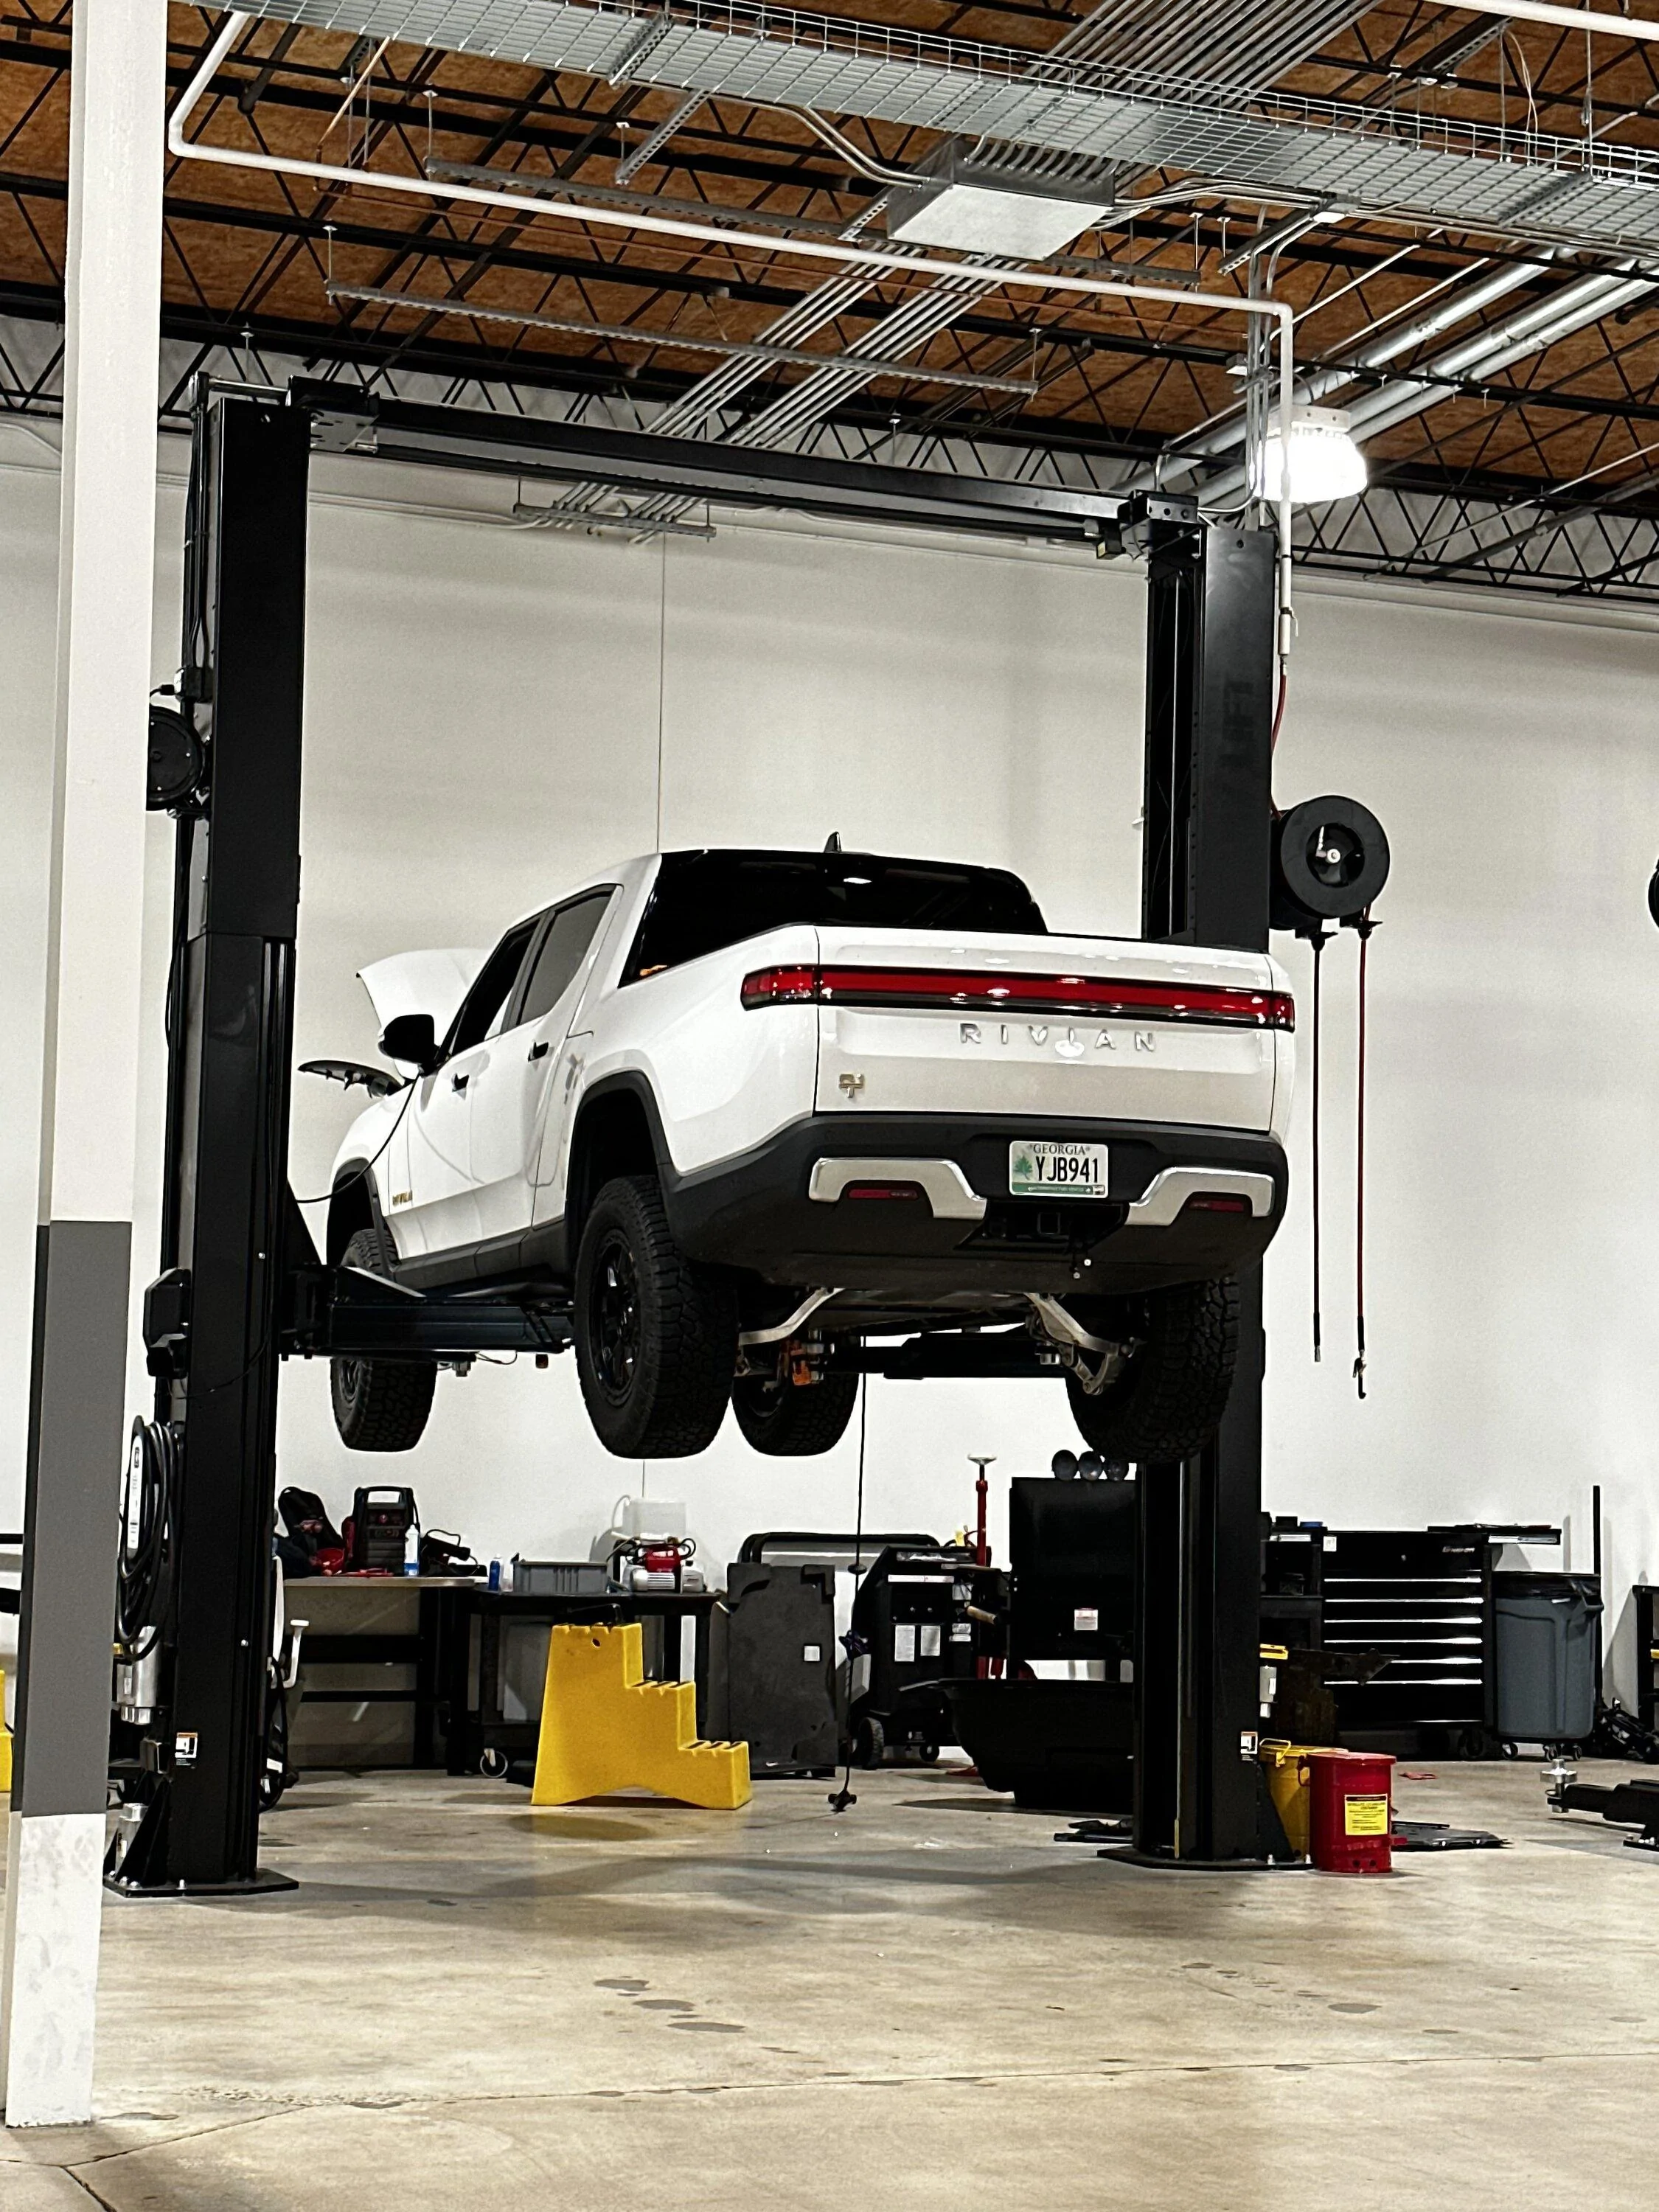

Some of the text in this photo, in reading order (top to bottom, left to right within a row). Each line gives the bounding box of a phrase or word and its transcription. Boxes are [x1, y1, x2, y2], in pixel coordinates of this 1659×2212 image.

[959, 1023, 1155, 1051] RIVIAN
[1033, 1144, 1085, 1155] GEORGIA
[1035, 1155, 1098, 1184] YJB941
